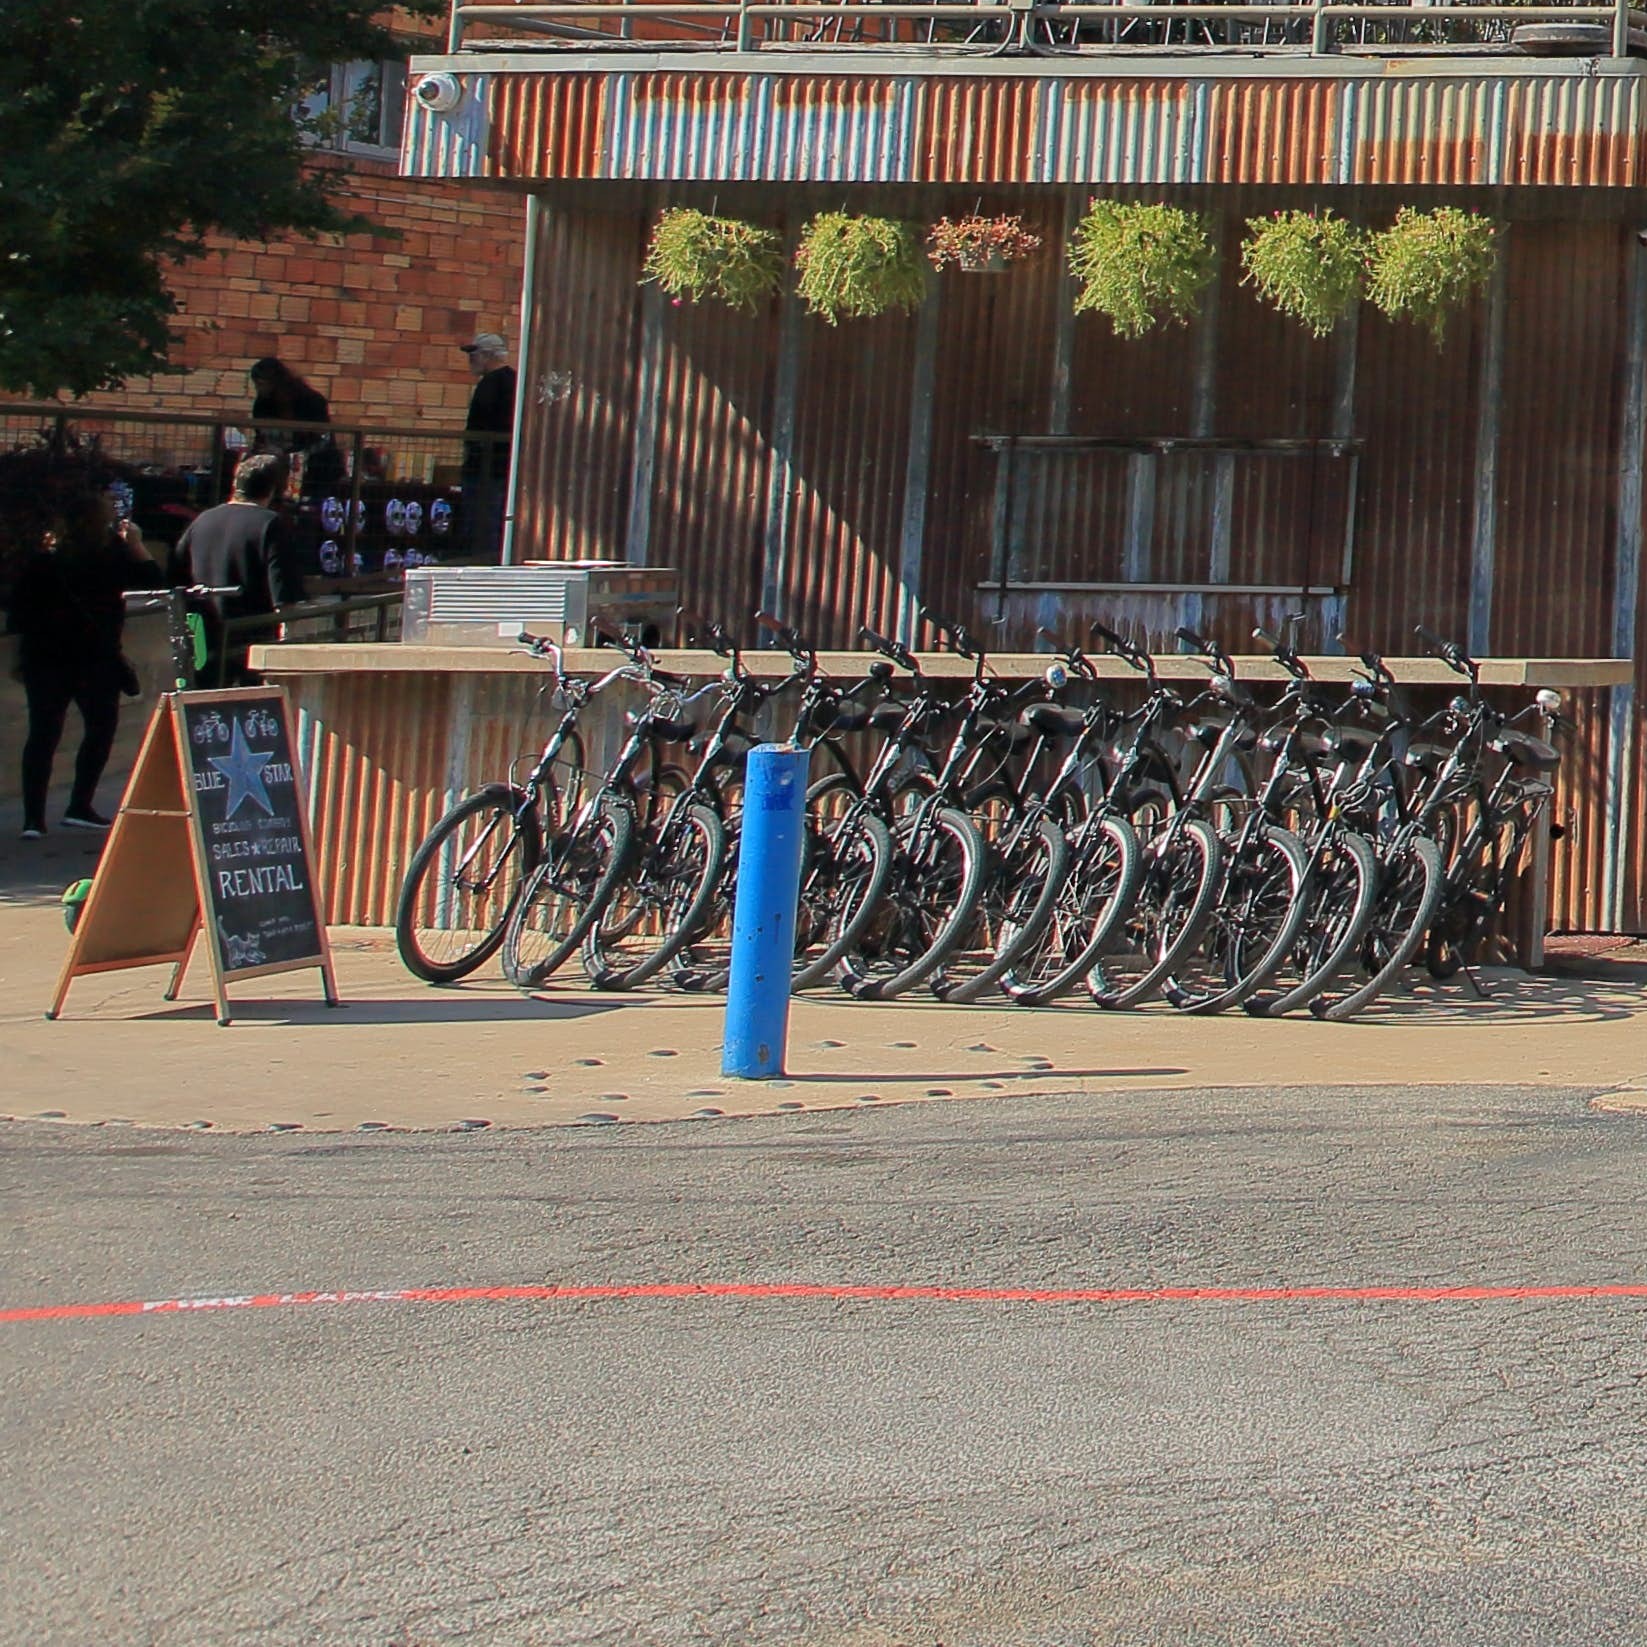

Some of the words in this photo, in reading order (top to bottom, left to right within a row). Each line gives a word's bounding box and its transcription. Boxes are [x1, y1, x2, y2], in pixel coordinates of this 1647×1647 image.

[194, 772, 225, 791] BLUE
[263, 763, 294, 784] STAR
[212, 840, 250, 860] SALES
[218, 864, 304, 900] RENTAL
